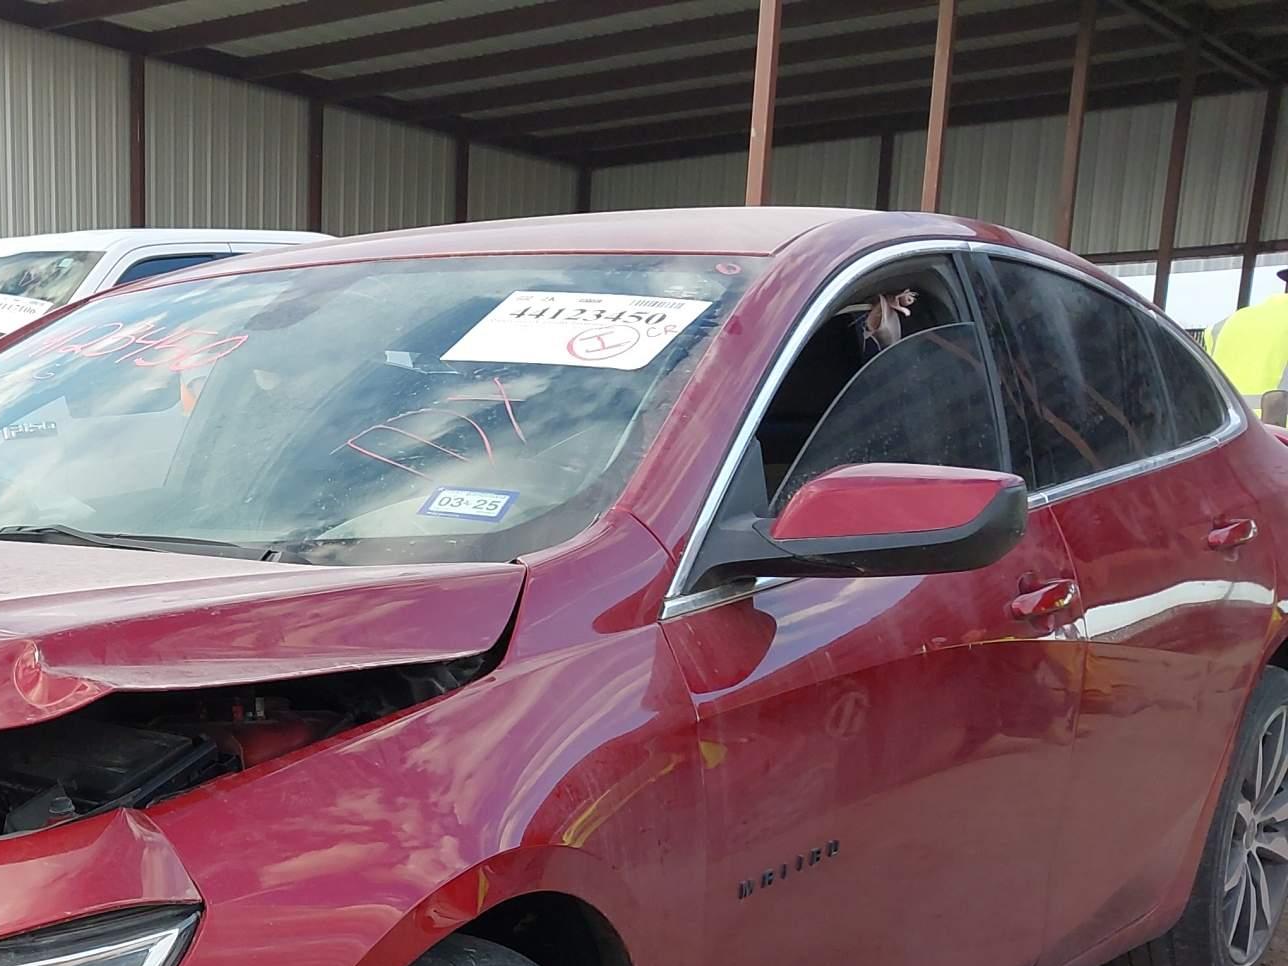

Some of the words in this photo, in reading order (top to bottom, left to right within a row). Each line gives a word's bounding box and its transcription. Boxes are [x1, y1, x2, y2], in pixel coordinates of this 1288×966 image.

[509, 305, 668, 325] 44123450
[437, 496, 465, 508] 03
[471, 498, 501, 511] 25
